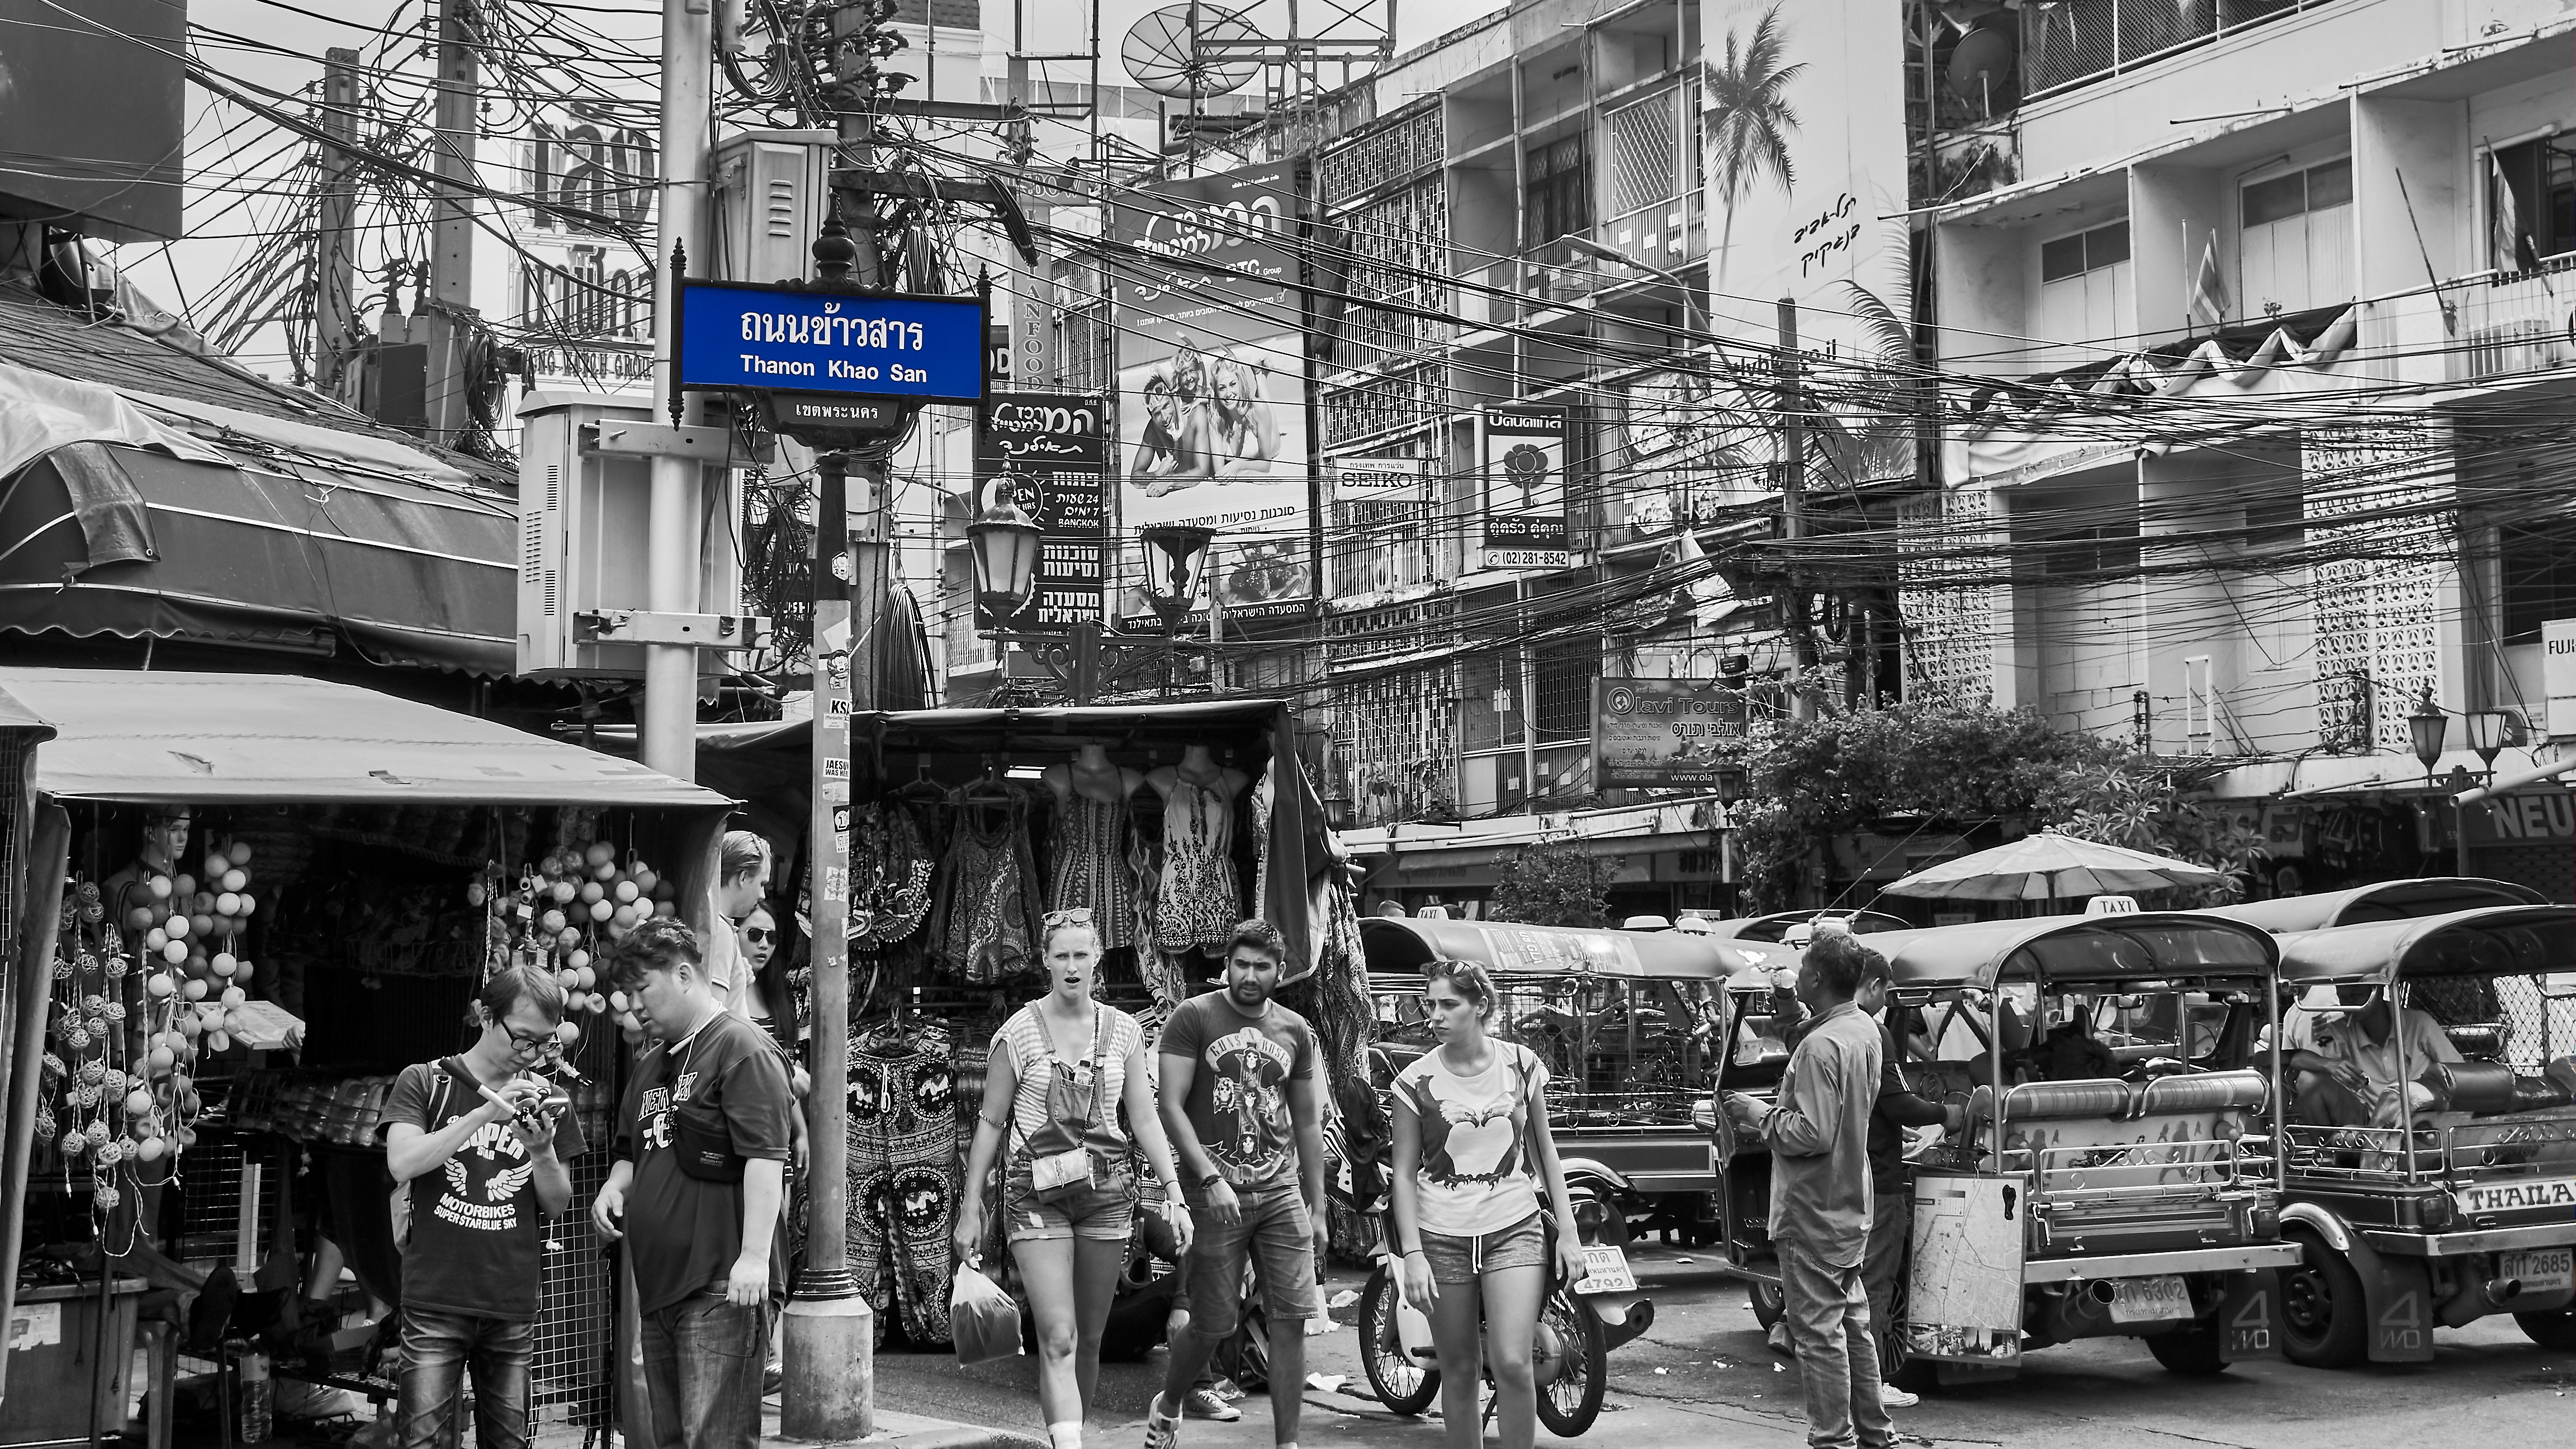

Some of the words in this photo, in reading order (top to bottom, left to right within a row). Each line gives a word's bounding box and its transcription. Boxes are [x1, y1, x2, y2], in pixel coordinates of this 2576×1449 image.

[1263, 266, 1282, 276] Group
[741, 302, 923, 351] ถนนข้าวสาร
[564, 351, 608, 378] WATCH
[615, 354, 654, 380] GROU
[740, 354, 815, 376] Thanon
[828, 360, 879, 380] Khao
[890, 363, 927, 383] San
[795, 403, 878, 419] เขตพระนคร
[1342, 472, 1412, 487] SEIKO
[1012, 487, 1035, 501] EN
[1055, 494, 1085, 503] שעות
[1087, 495, 1098, 504] 24
[1092, 507, 1099, 516] 7
[1221, 509, 1256, 523] נסיעות
[1261, 506, 1295, 519] סוכנות
[1058, 519, 1099, 528] BANGKOK
[1043, 545, 1099, 560] סוכנות
[1043, 562, 1099, 577] נסיעות
[1043, 591, 1099, 607] מסעדה
[1038, 605, 1100, 623] ישראלית
[1222, 607, 1265, 620] הישראלית
[1269, 603, 1305, 615] המסעדה
[1128, 618, 1162, 629] בתאילנד
[1679, 698, 1739, 714] Tours
[1671, 722, 1704, 737] תורס
[1671, 773, 1713, 782] www.ola
[1422, 910, 1437, 918] TAXI
[2100, 901, 2133, 913] TAXI
[477, 1146, 495, 1161] STAR
[2467, 1181, 2576, 1210] THAILA
[439, 1192, 515, 1218] MOTORBIKES
[503, 1218, 517, 1229] SKY
[1588, 1252, 1611, 1263] กต
[2532, 1253, 2570, 1275] 2685
[2142, 1280, 2185, 1301] 6302
[2232, 1290, 2270, 1328] 4
[2379, 1290, 2420, 1327] 4
